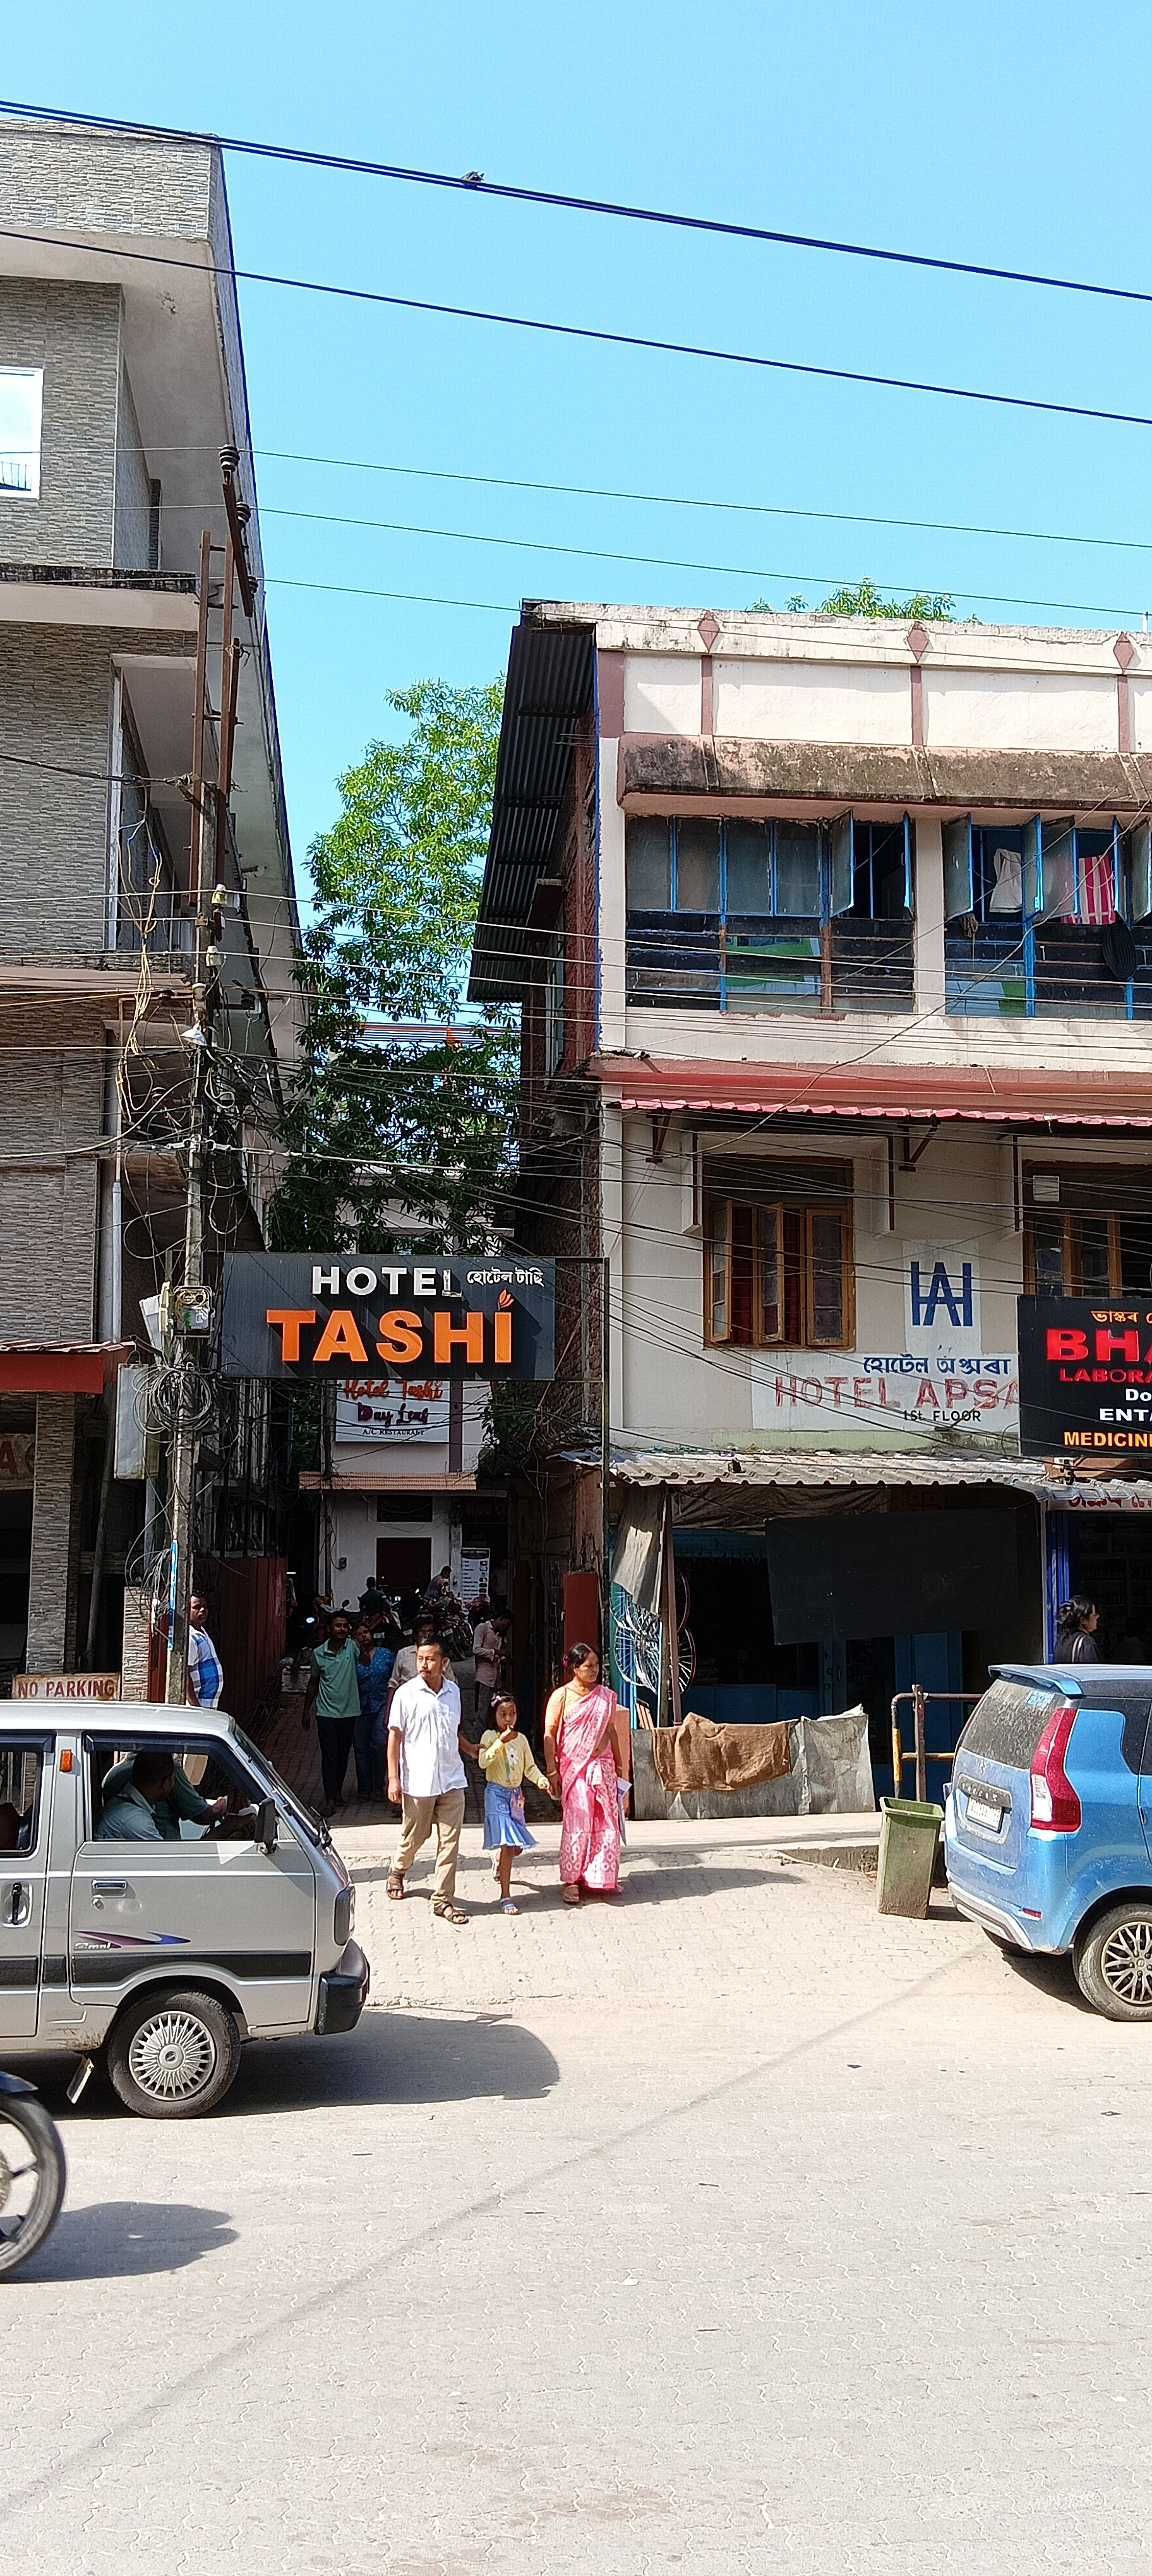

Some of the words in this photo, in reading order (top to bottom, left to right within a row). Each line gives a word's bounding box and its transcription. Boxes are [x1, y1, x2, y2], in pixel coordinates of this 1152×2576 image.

[312, 1266, 463, 1297] HOTEL
[467, 1267, 513, 1285] হোটেল
[515, 1267, 544, 1287] টাছি
[1091, 1310, 1139, 1323] ভাস্কৰ
[266, 1309, 512, 1363] TASHI
[1046, 1328, 1152, 1363] BH
[864, 1354, 928, 1374] হোটেল
[344, 1380, 390, 1400] Hotel
[395, 1380, 443, 1400] Tashi
[776, 1376, 900, 1408] HOTEL
[933, 1410, 981, 1422] FLOOR
[1100, 1408, 1152, 1422] ENT
[1064, 1431, 1152, 1447] MEDICIN
[18, 1681, 39, 1698] NO
[45, 1679, 115, 1698] PARKING
